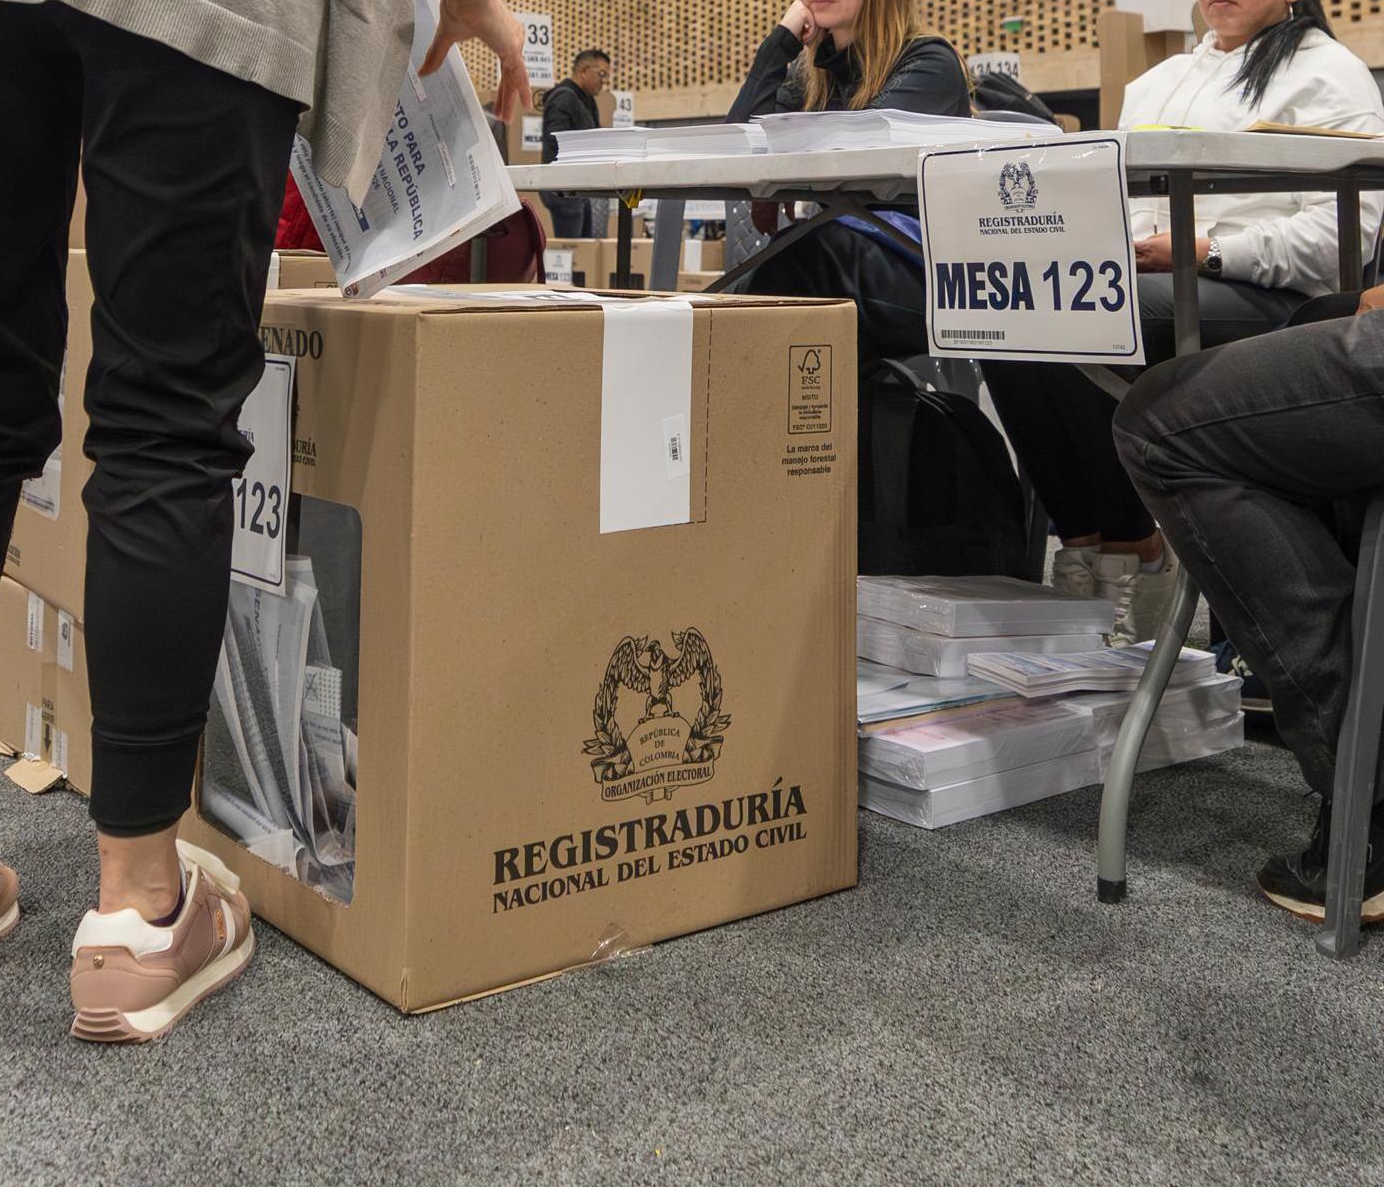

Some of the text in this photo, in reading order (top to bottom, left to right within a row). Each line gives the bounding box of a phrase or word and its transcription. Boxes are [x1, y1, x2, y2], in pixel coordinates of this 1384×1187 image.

[527, 23, 550, 45] 33
[619, 97, 632, 112] 43
[403, 130, 426, 177] PARA
[379, 168, 400, 214] NACIONAL
[394, 152, 424, 241] REPÚBLICA
[978, 211, 1065, 228] REGISTRADURÍA
[1024, 226, 1048, 234] ESTADO
[1049, 225, 1065, 233] CIVIL
[935, 260, 1126, 312] MESA 123
[260, 326, 324, 360] ENADO
[801, 375, 821, 385] FSC
[786, 442, 832, 453] La marca del
[781, 453, 837, 467] manejo forestal
[787, 466, 832, 477] responsable
[236, 477, 282, 540] 123
[639, 726, 680, 745] REPÚBLICA
[654, 739, 665, 749] DE
[639, 751, 680, 767] COLOMBIA
[605, 765, 712, 799] ORGANIZACIÓN ELECTORAL
[493, 776, 807, 885] REGISTRADURÍA
[493, 822, 807, 914] NACIONAL DEL ESTADO CIVIL
